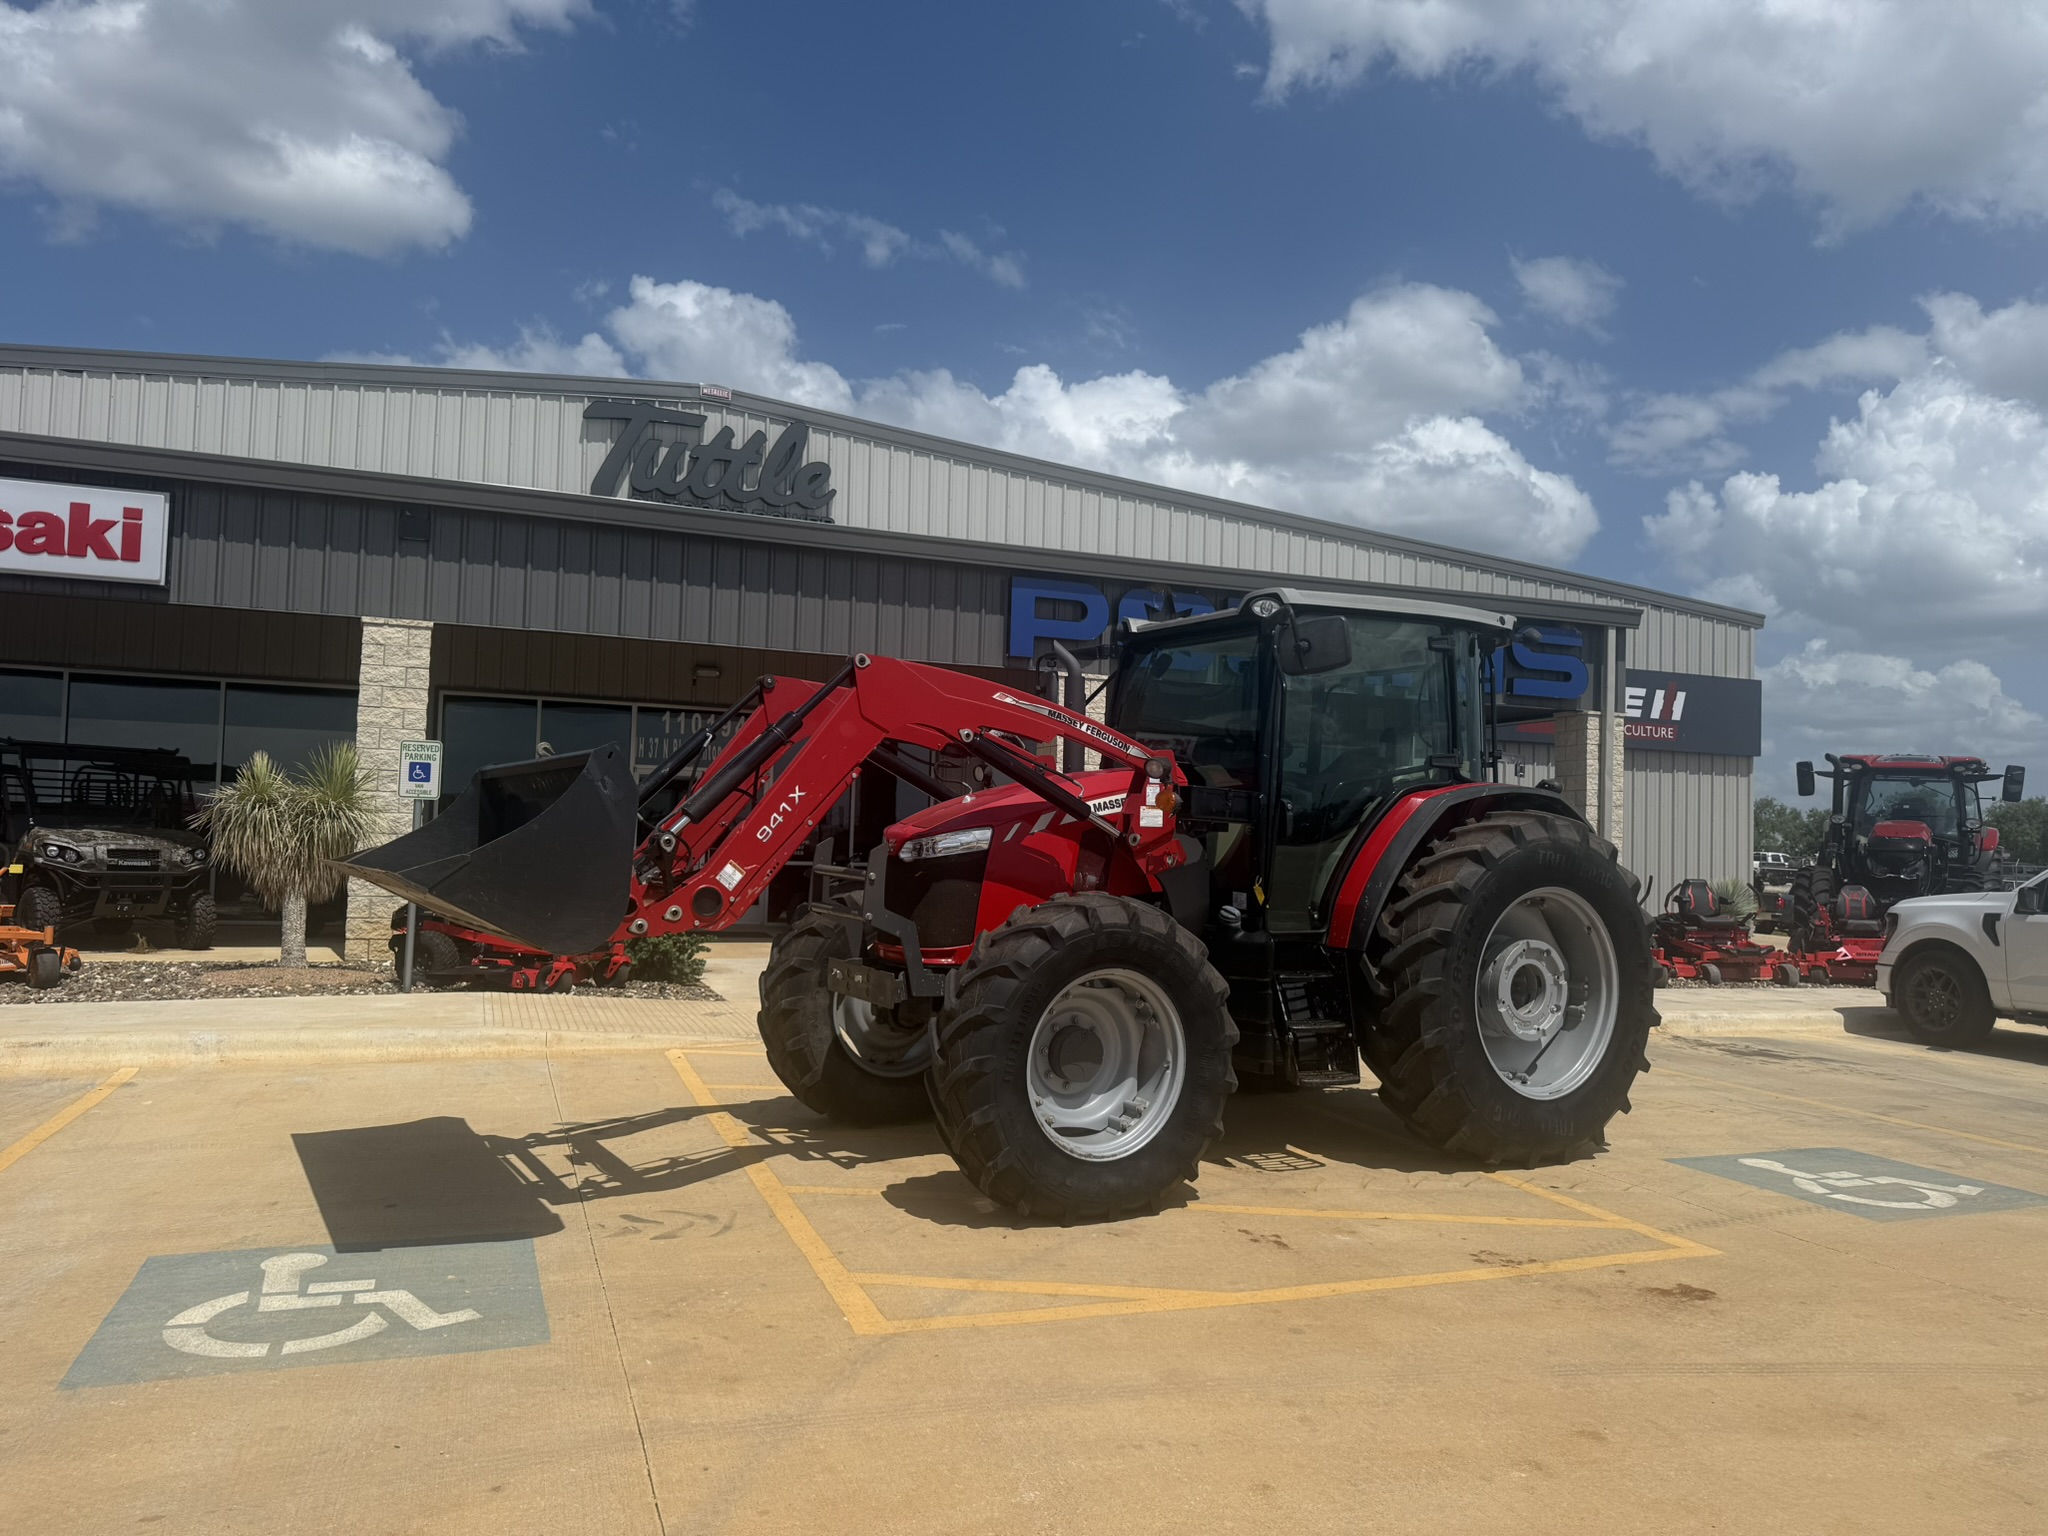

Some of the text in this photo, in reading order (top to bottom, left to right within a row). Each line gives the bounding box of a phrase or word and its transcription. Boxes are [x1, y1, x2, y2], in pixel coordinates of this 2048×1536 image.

[702, 386, 729, 398] METALLIC
[582, 400, 837, 510] Tuttle
[0, 501, 144, 563] aki
[1047, 709, 1084, 730] MASSEY
[1086, 724, 1131, 752] FERGUSON
[402, 743, 440, 753] RESERVED
[404, 752, 437, 761] PARKING
[118, 859, 152, 867] Kawasaki
